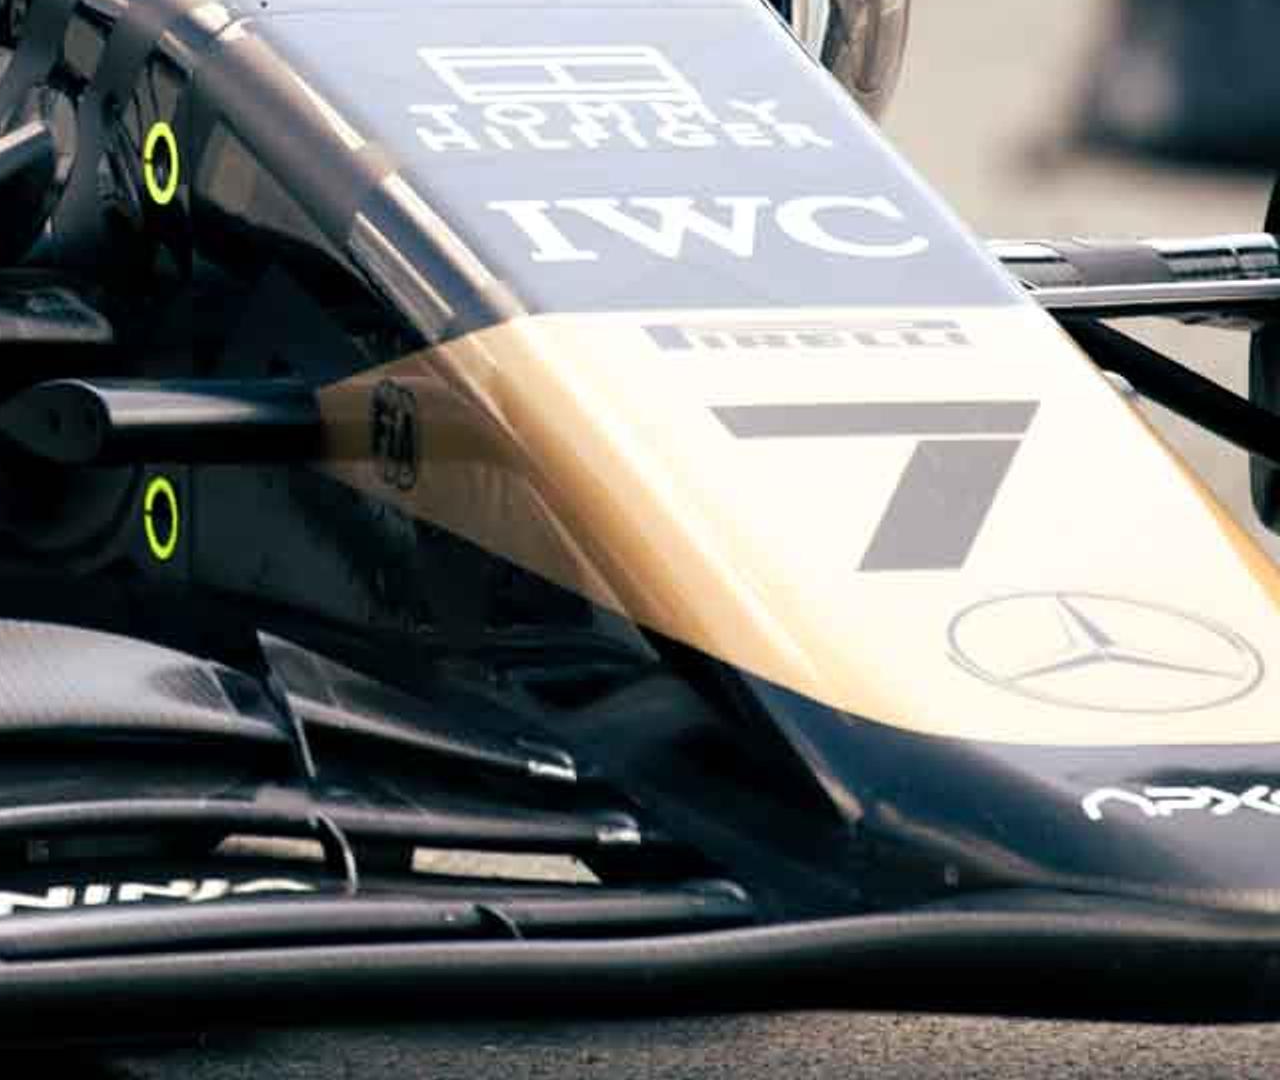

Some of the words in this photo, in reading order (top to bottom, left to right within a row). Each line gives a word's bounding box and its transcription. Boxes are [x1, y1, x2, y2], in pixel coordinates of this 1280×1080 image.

[407, 97, 782, 129] TOMMY
[414, 121, 833, 152] HILFIGER
[485, 193, 931, 265] IWC
[644, 319, 973, 352] PIRELLI
[708, 399, 1041, 573] 7
